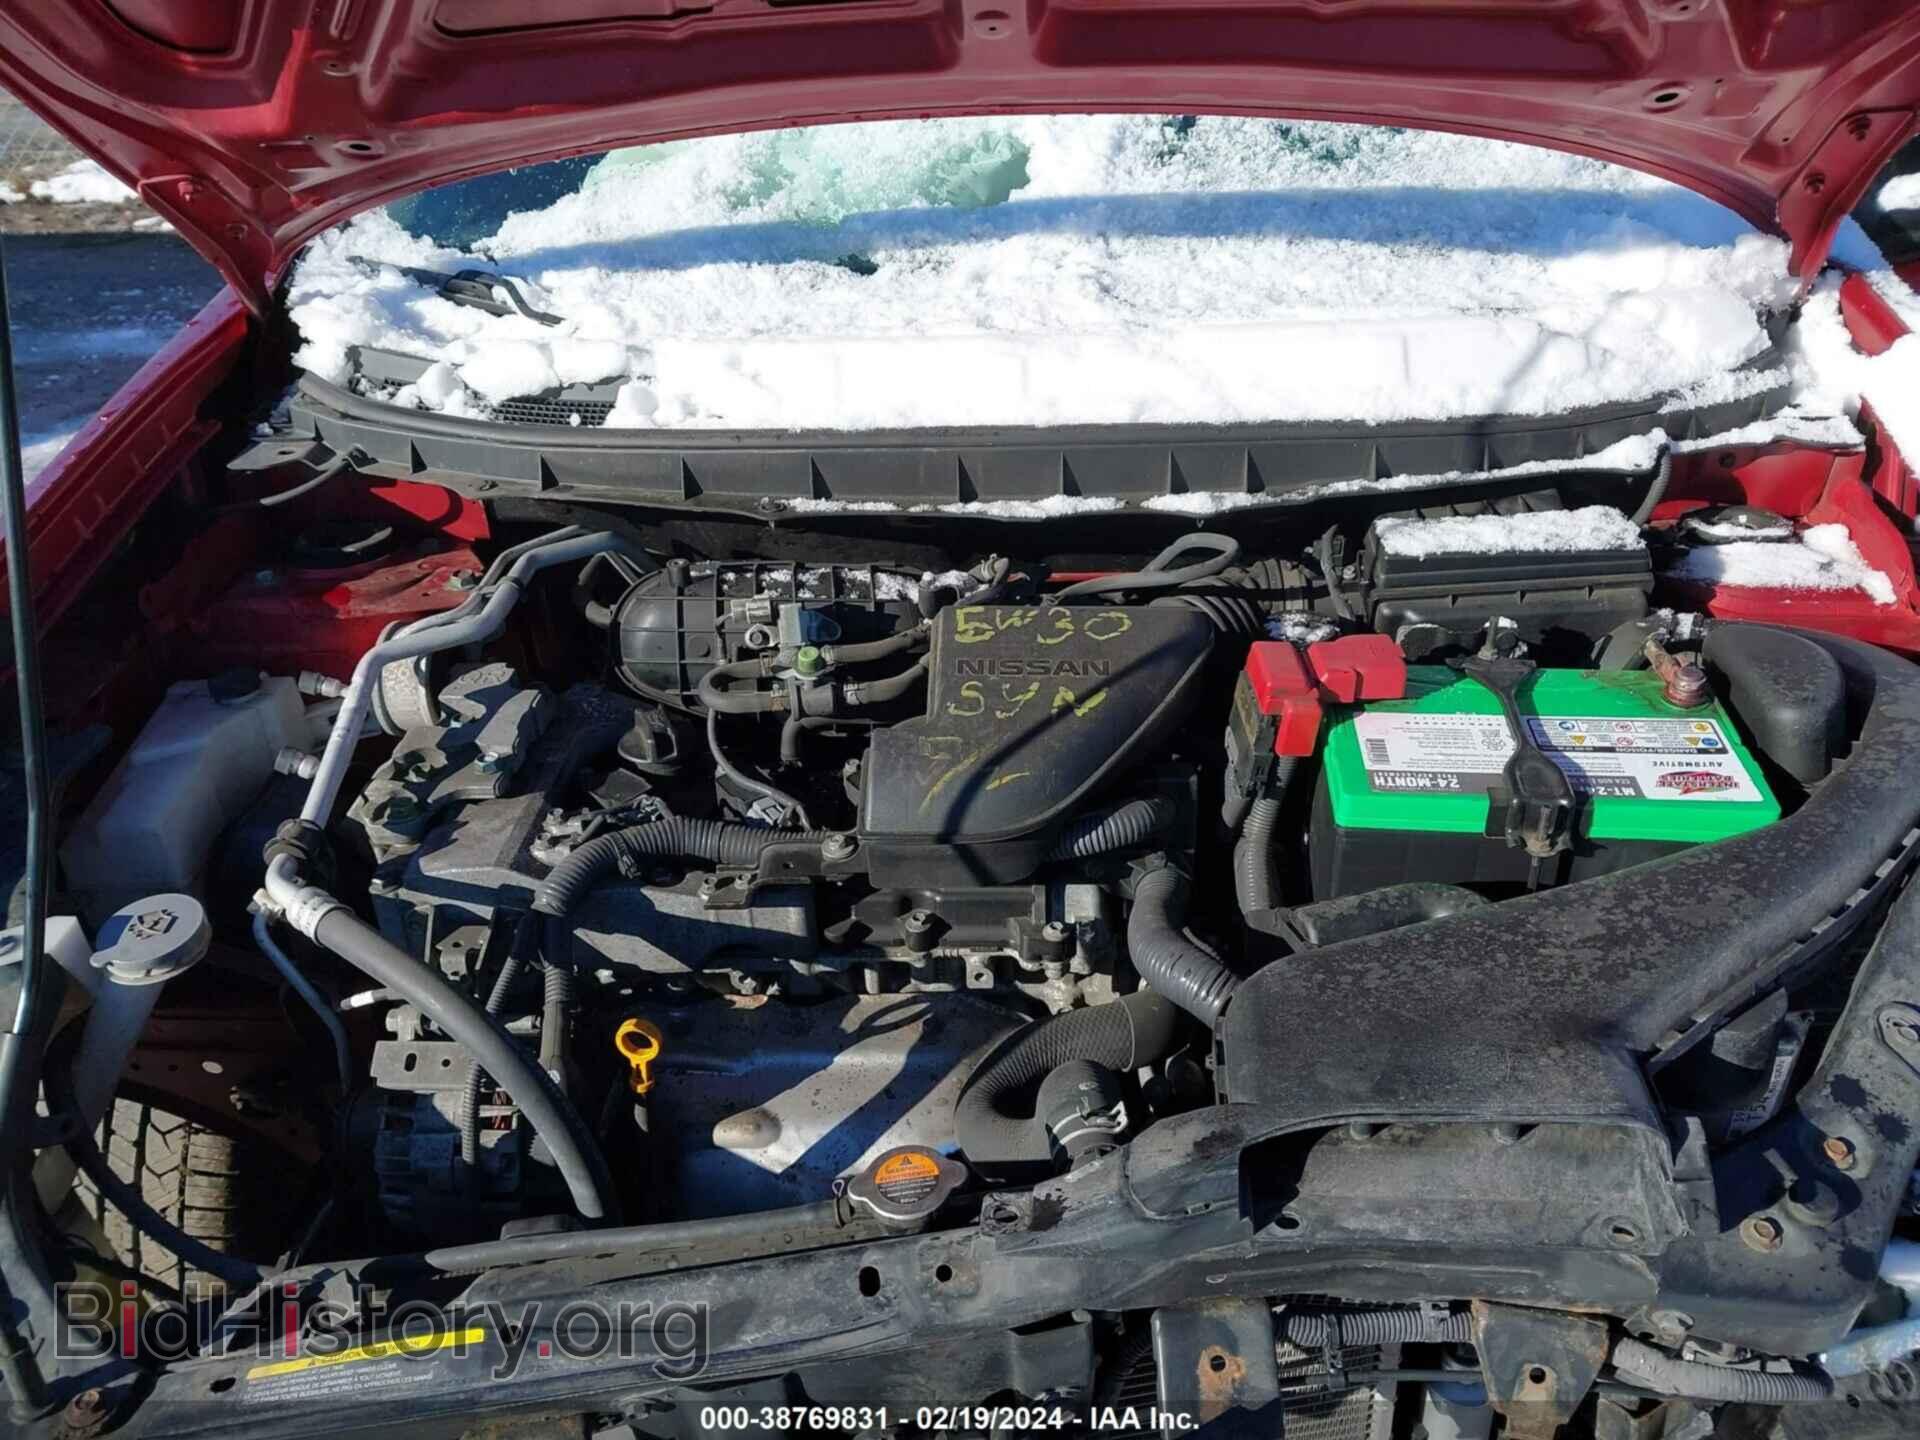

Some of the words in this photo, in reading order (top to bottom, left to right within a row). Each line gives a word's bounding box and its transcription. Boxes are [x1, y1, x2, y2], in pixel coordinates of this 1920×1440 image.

[956, 658, 1112, 678] NISSAN
[1652, 761, 1724, 769] AUTOMOTIVE
[1374, 776, 1461, 788] 24-MONTH
